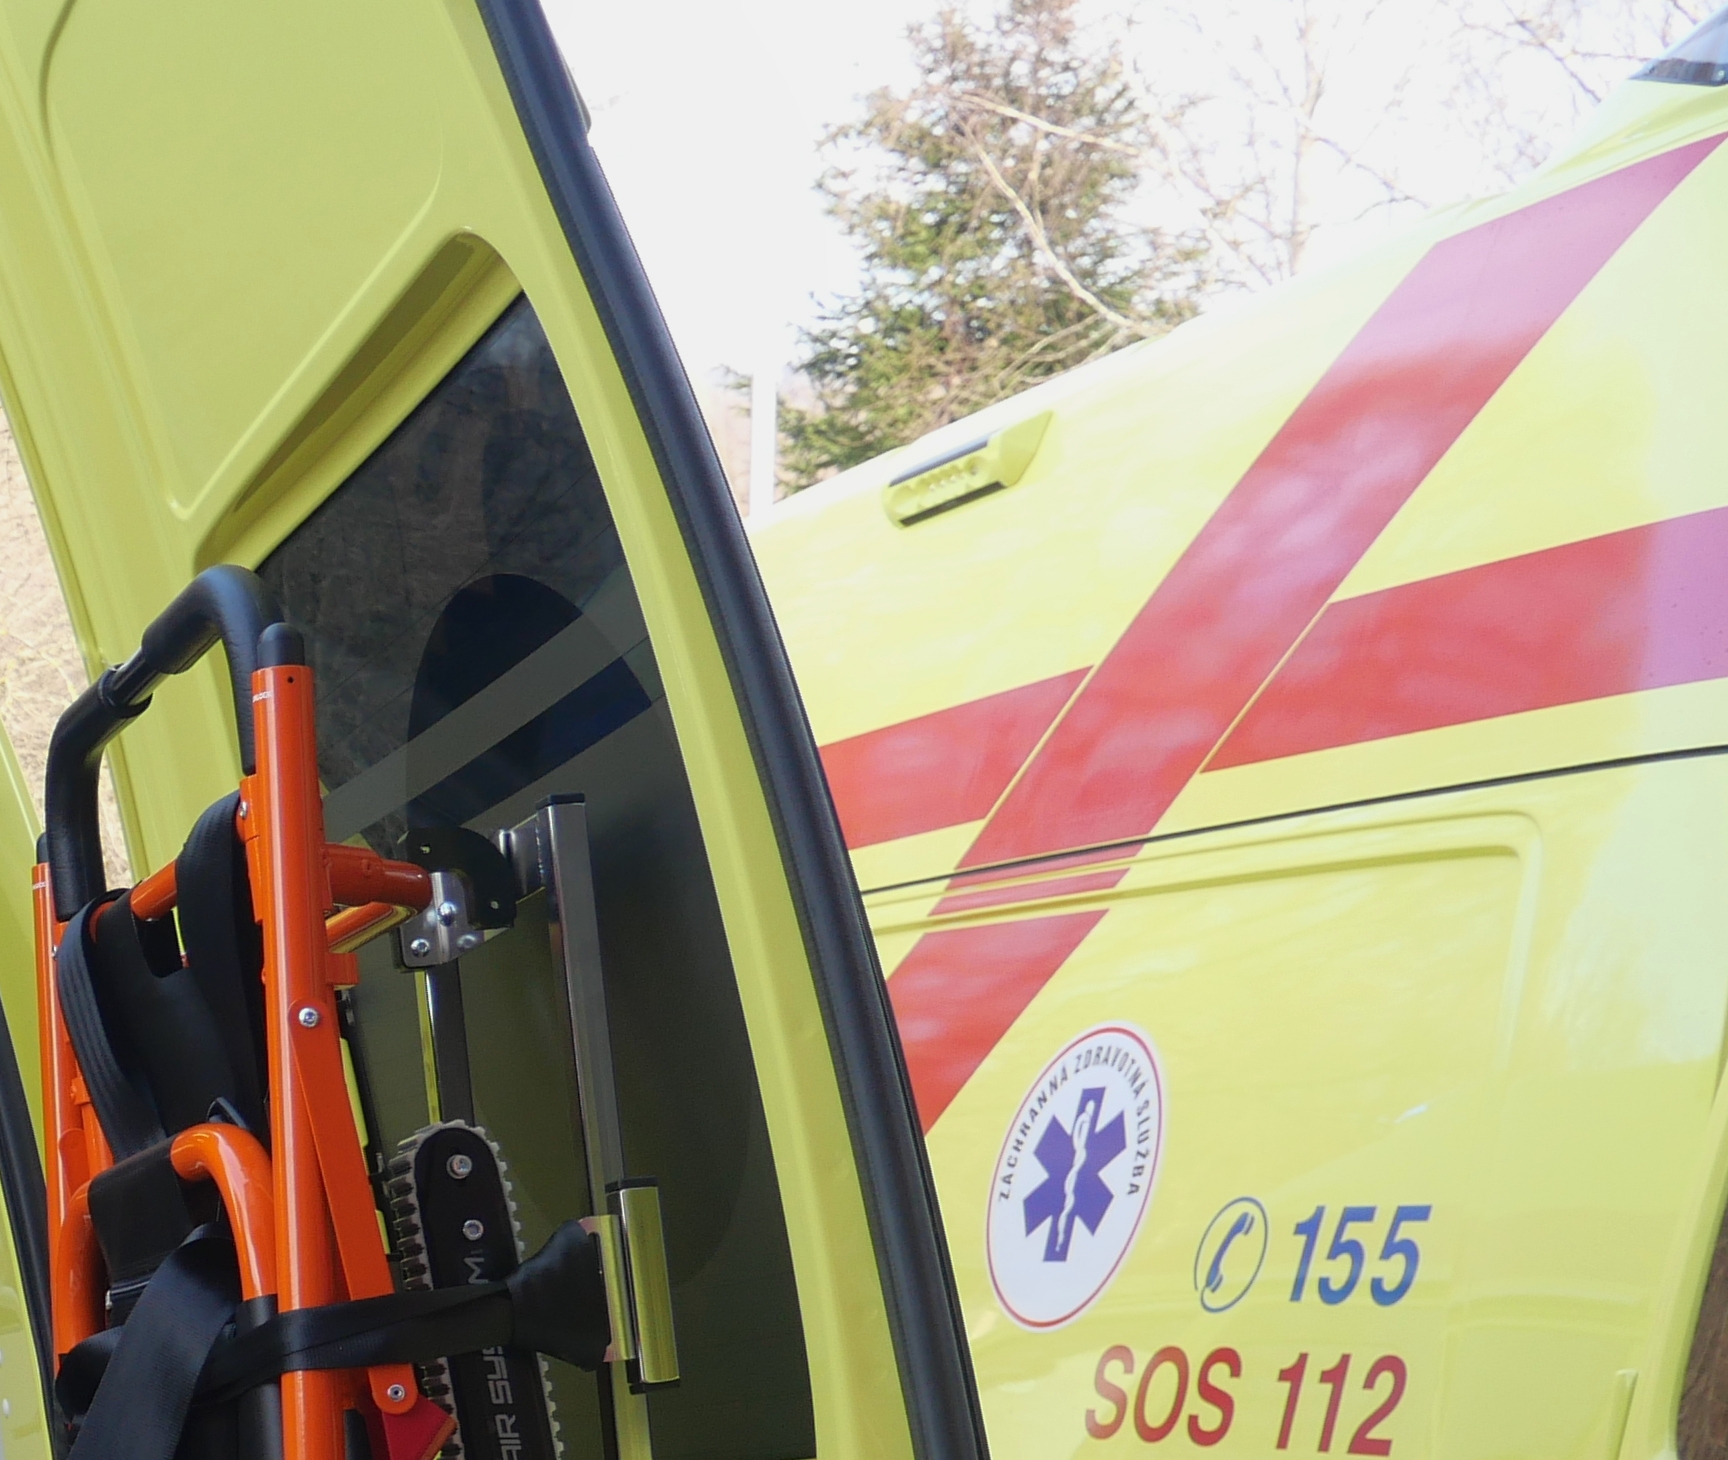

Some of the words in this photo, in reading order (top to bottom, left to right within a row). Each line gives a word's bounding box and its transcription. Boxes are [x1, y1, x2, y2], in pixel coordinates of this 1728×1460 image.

[1289, 1203, 1431, 1306] 155
[1084, 1344, 1243, 1447] SOS
[1274, 1352, 1409, 1456] 112
